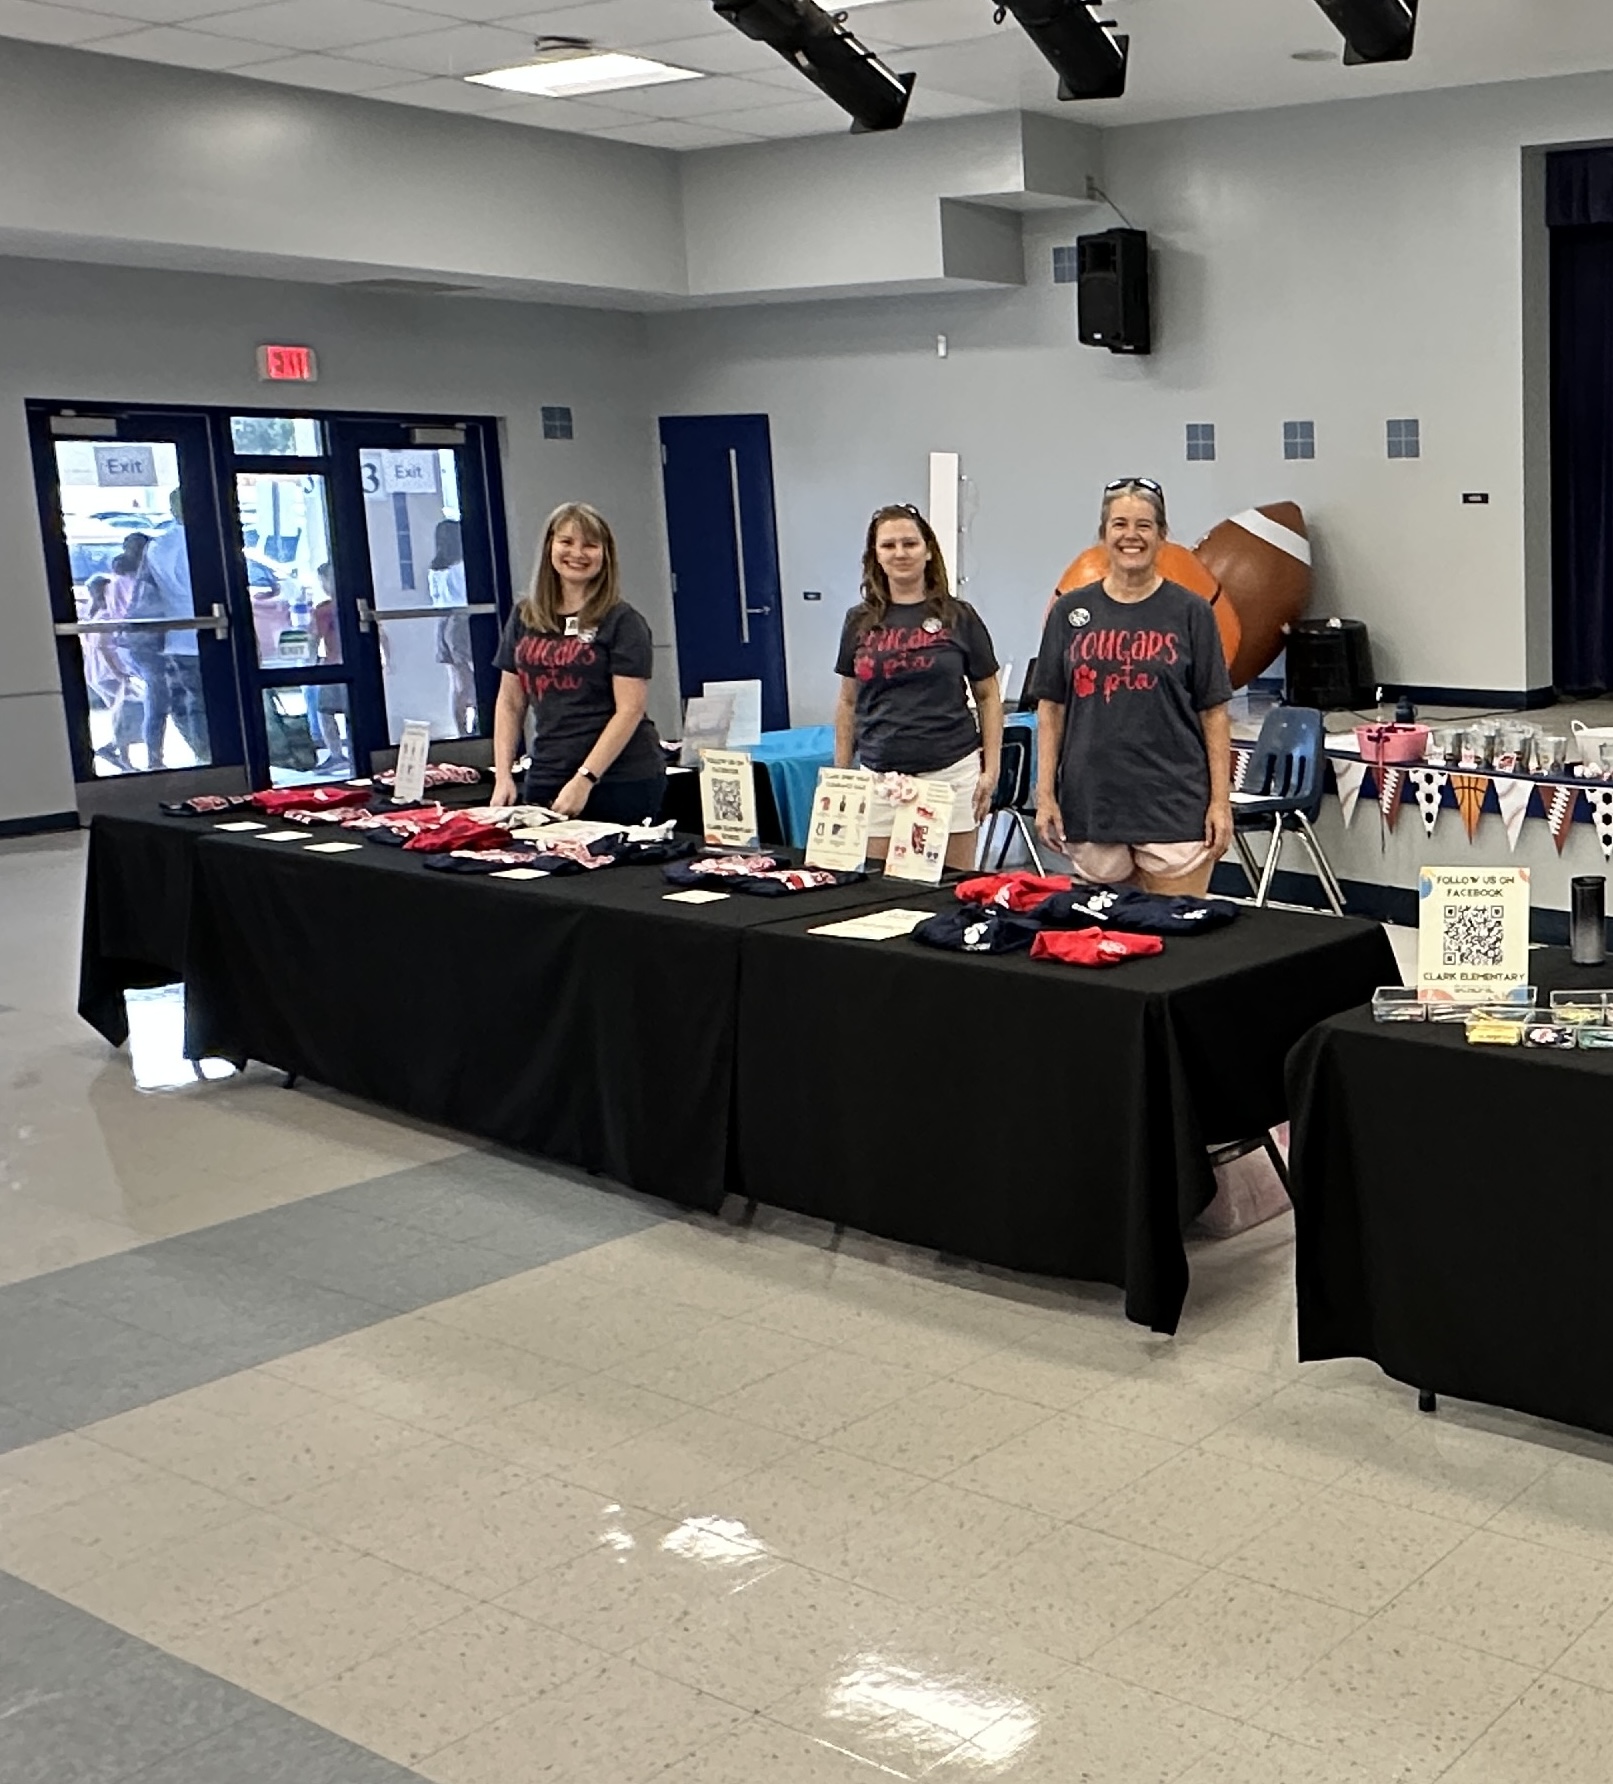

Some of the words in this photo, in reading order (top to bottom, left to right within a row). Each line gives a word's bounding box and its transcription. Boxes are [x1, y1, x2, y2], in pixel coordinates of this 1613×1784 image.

[107, 458, 142, 474] Exit
[395, 465, 422, 479] Exit
[361, 463, 379, 493] 3
[1436, 876, 1480, 885] FOLLOW
[1483, 876, 1496, 884] US
[1500, 876, 1515, 884] ON
[1447, 888, 1503, 897] FACEBOOK
[1423, 972, 1456, 981] CLARK
[1460, 972, 1525, 981] ELEMENTARY
